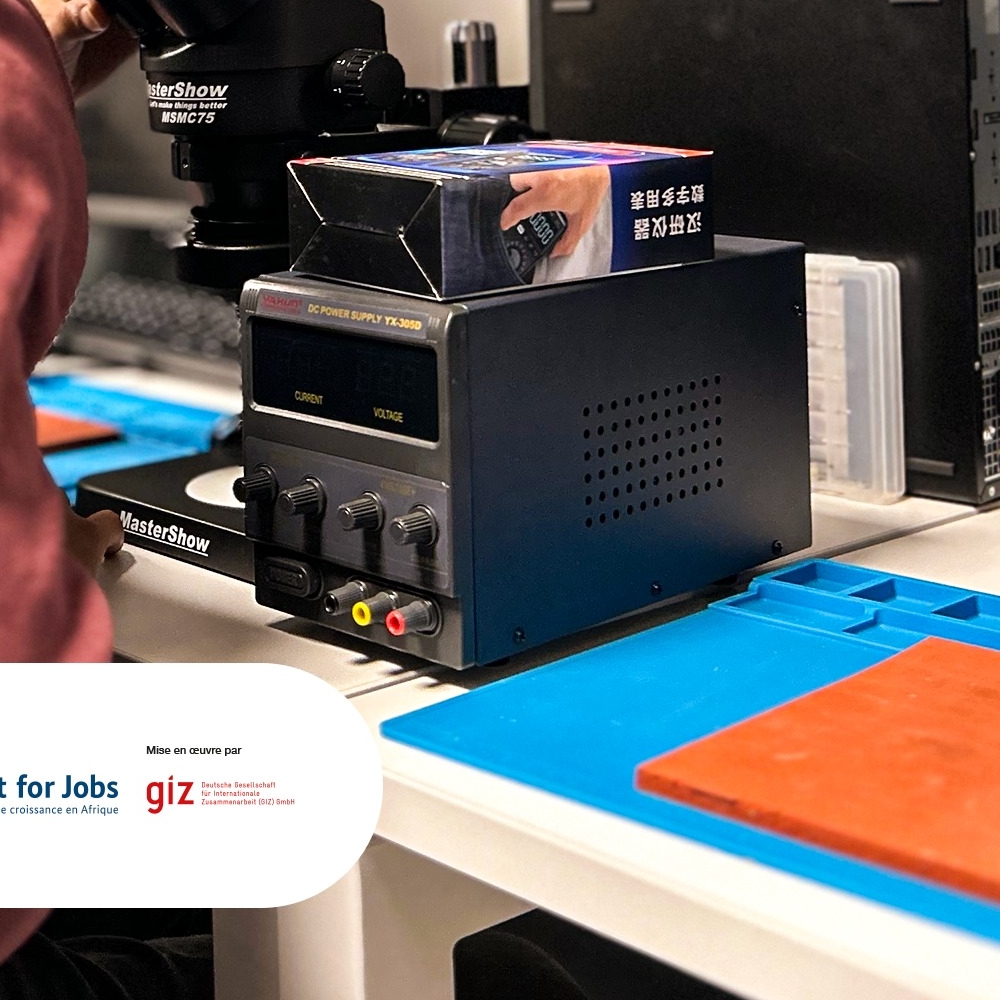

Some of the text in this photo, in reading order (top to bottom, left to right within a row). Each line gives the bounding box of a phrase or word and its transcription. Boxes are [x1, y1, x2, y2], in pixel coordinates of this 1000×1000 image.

[174, 101, 198, 110] things
[161, 111, 216, 123] MSMC75
[630, 184, 705, 211] 数字多用表
[633, 211, 702, 241] 汉研仪器
[307, 303, 320, 314] DC
[320, 306, 350, 319] POWER
[350, 311, 382, 324] SUPPLY
[384, 316, 422, 331] YX-305D
[294, 390, 324, 405] CURRENT
[373, 407, 404, 423] VOLTAGE
[120, 510, 211, 553] MasterShow
